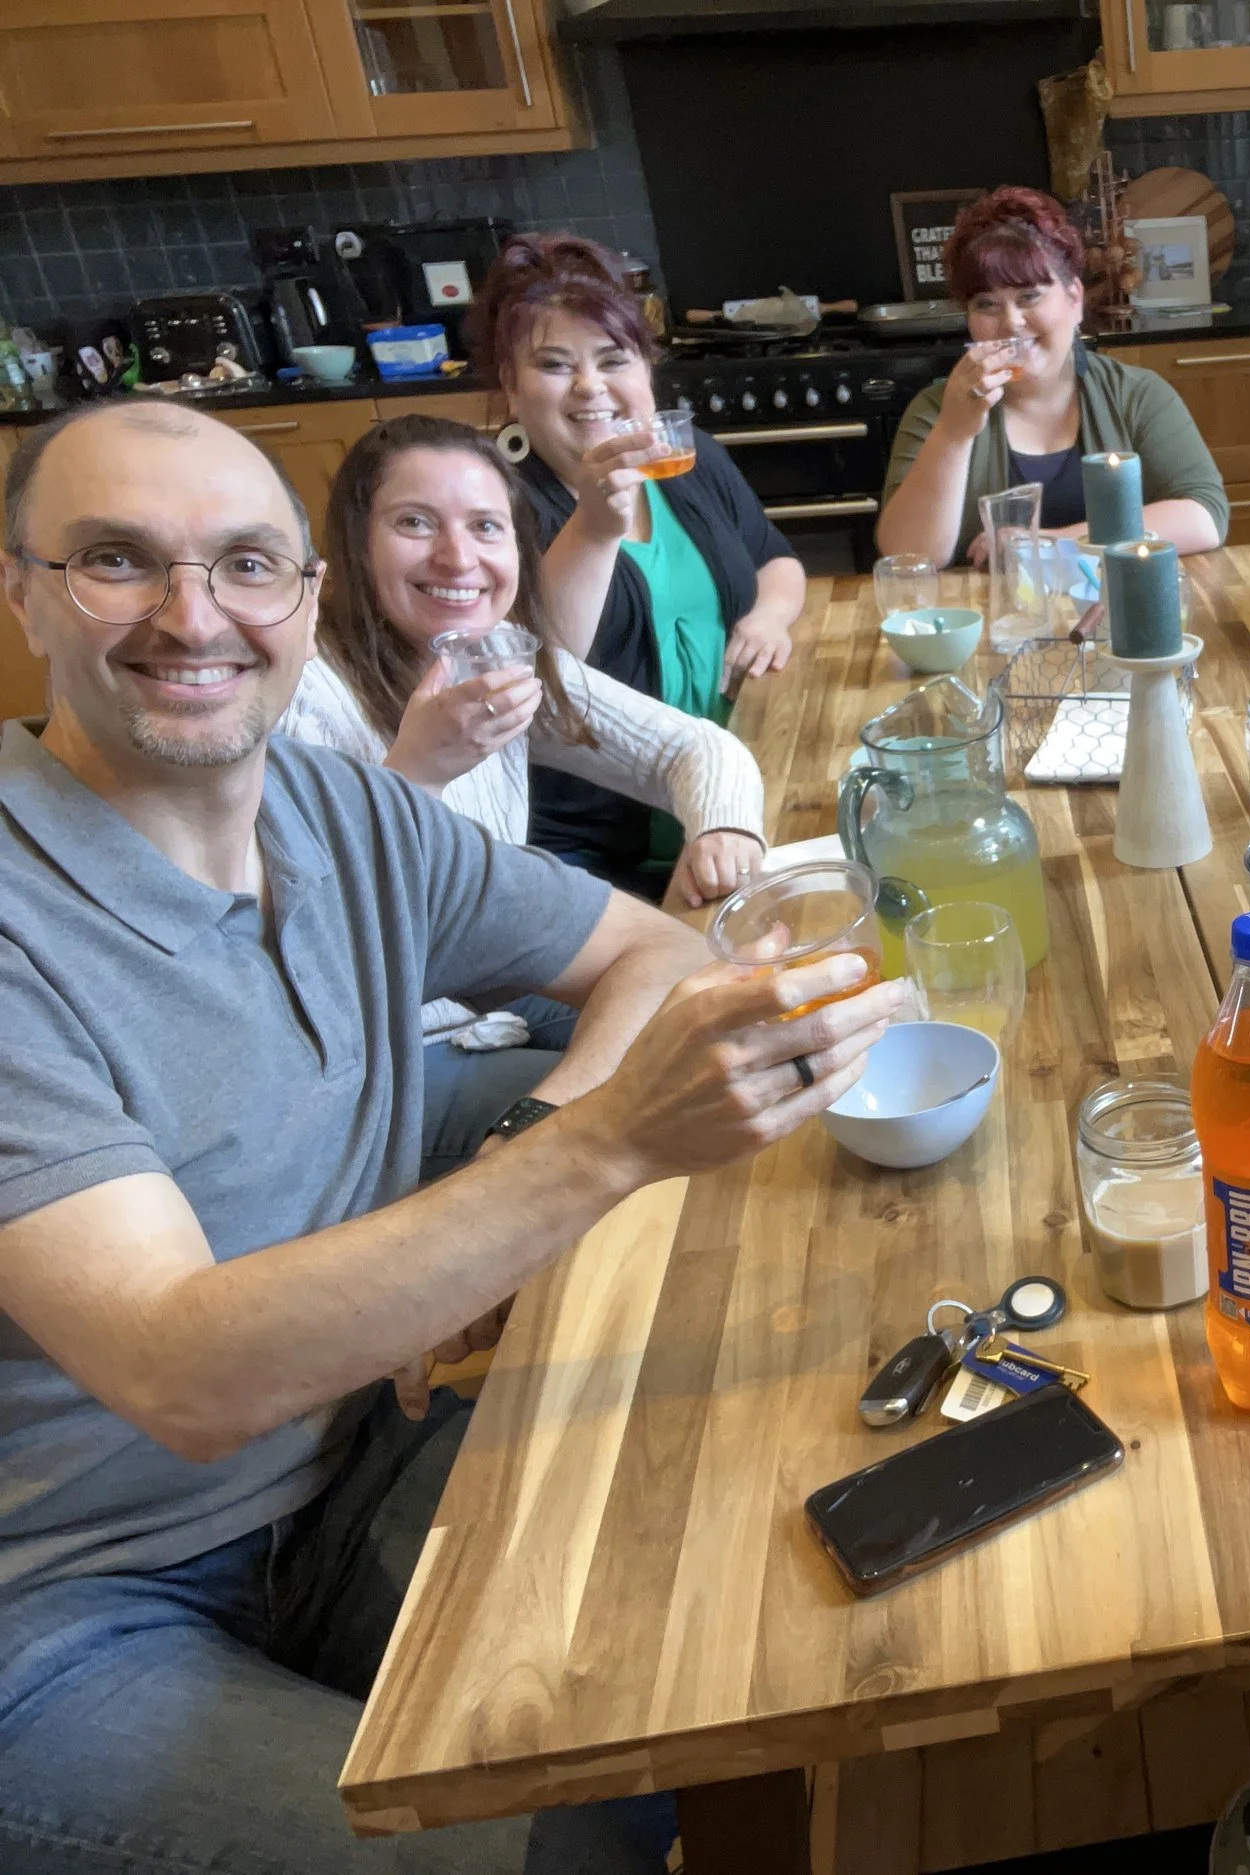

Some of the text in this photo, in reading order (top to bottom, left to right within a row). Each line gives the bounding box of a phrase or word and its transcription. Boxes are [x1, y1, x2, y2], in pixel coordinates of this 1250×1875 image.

[914, 245, 945, 261] THA
[916, 263, 946, 282] BLE
[1000, 1359, 1040, 1382] ubcard
